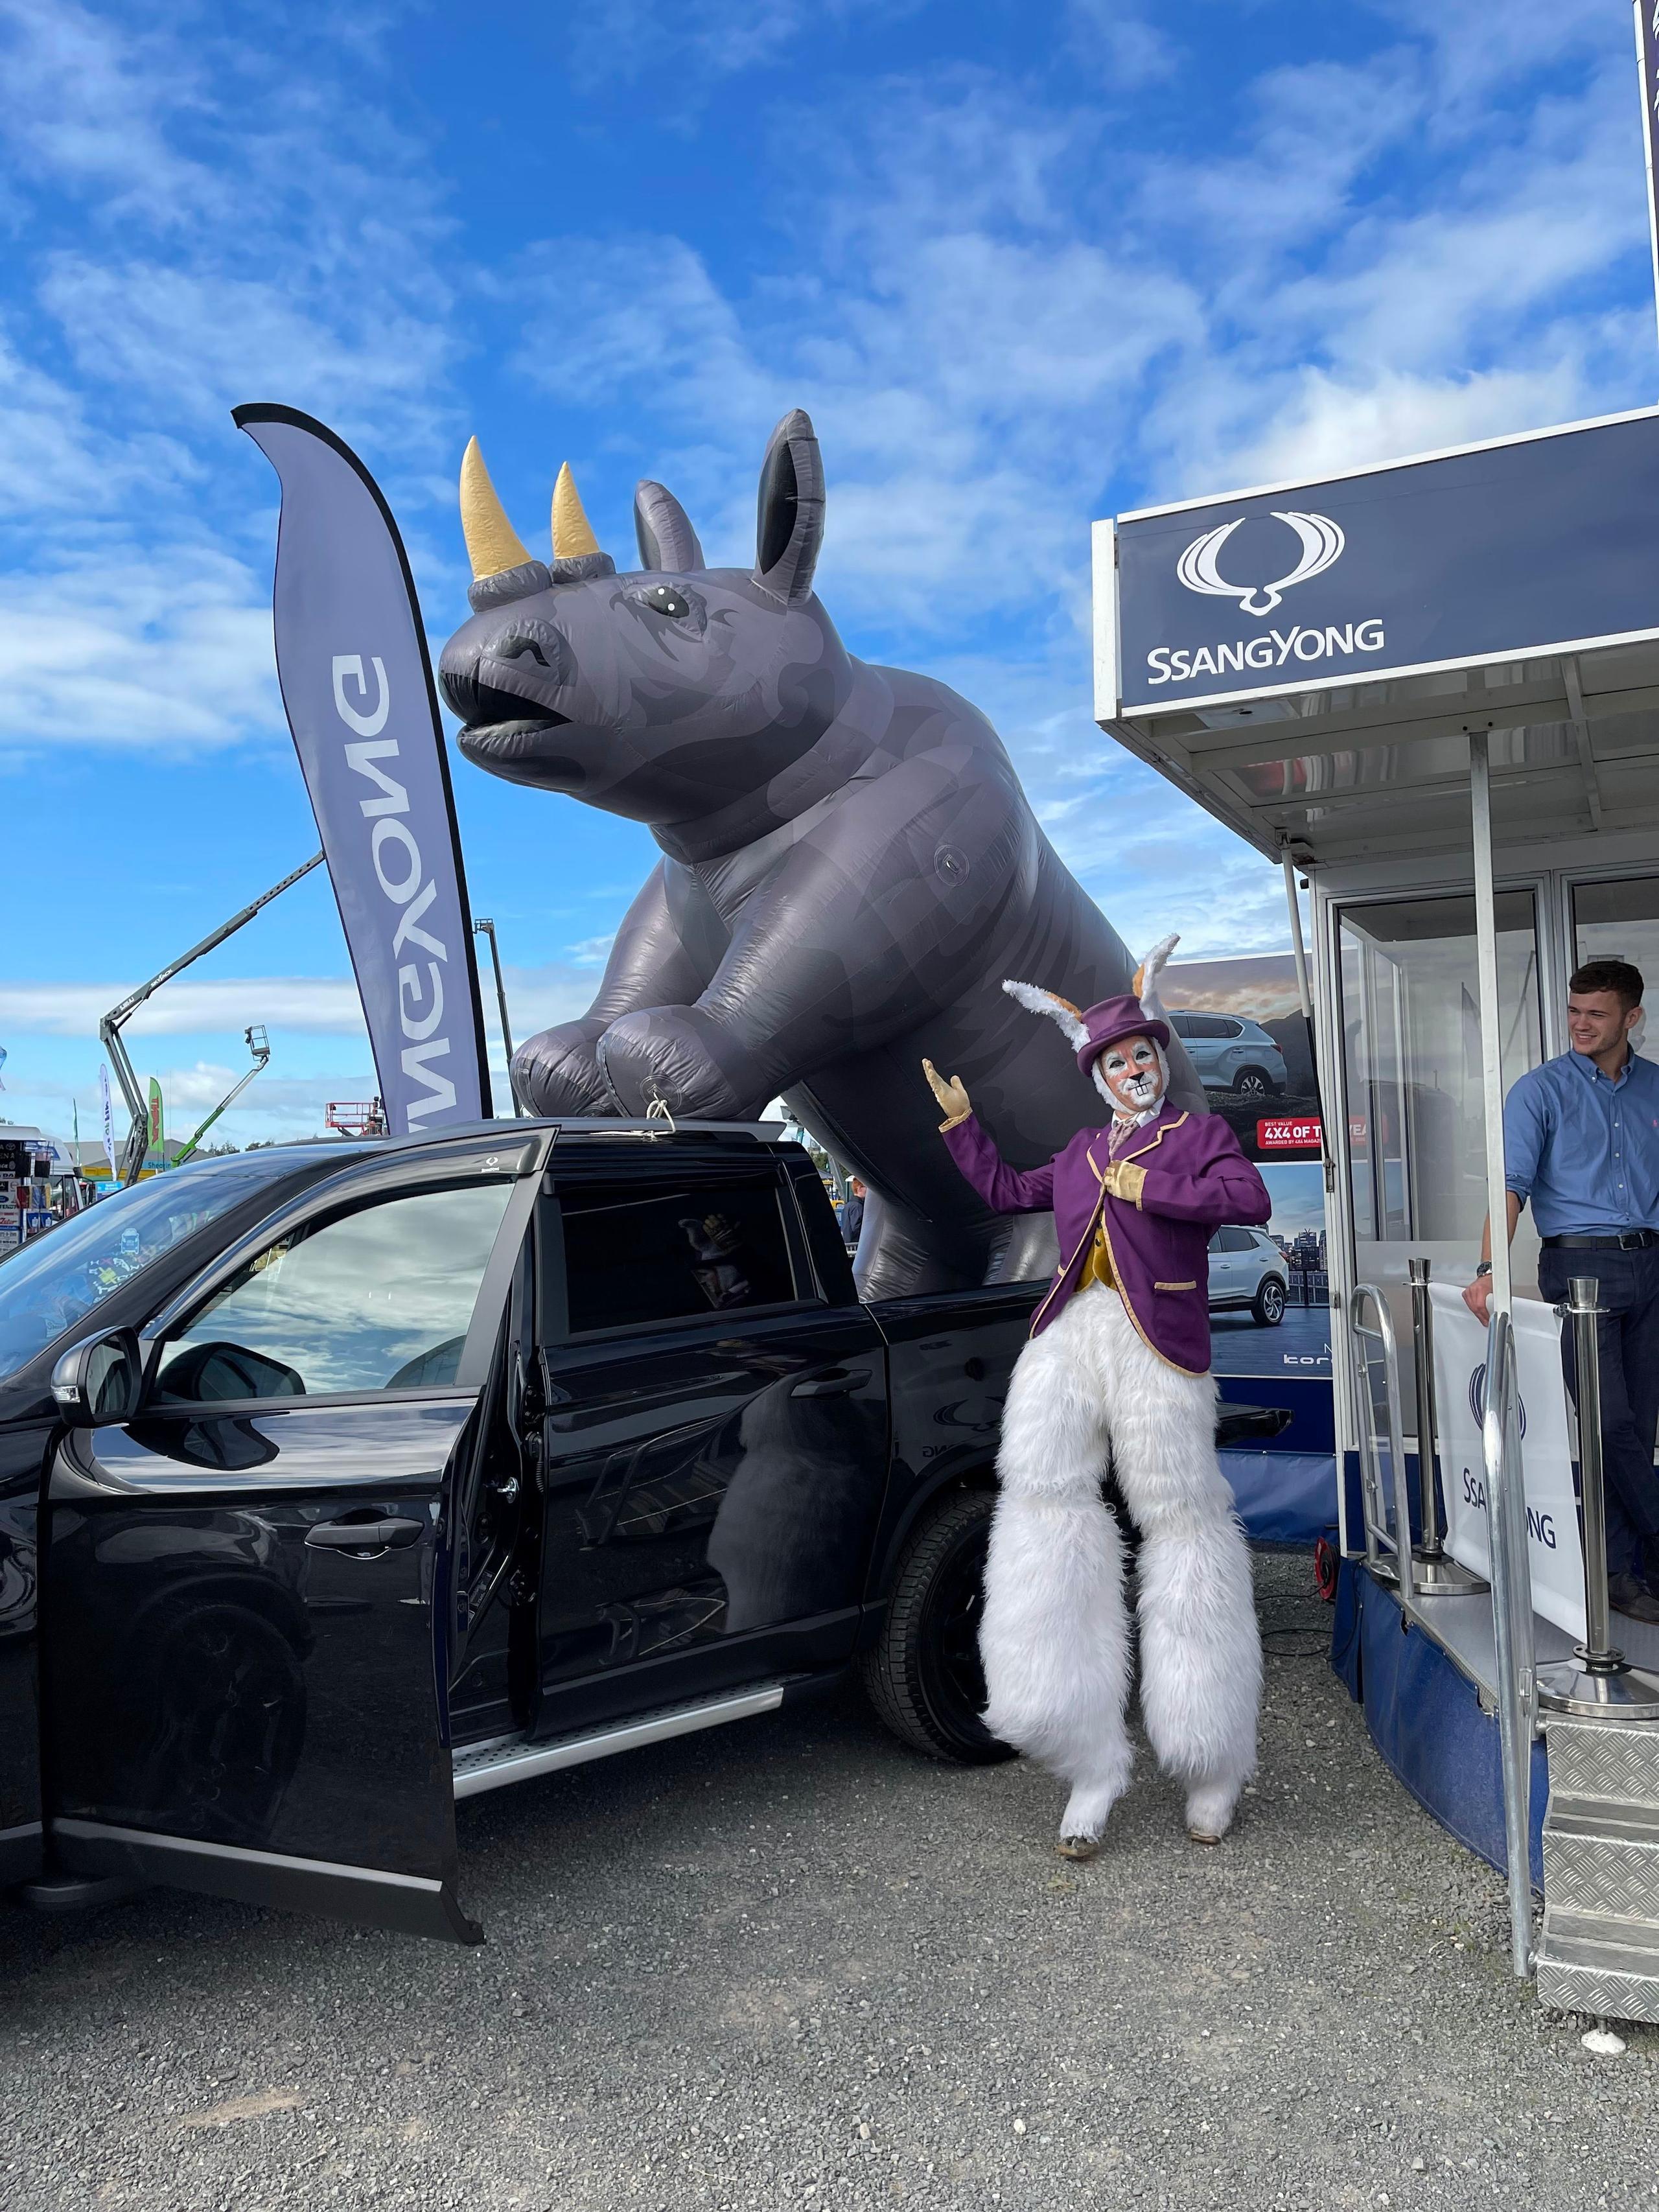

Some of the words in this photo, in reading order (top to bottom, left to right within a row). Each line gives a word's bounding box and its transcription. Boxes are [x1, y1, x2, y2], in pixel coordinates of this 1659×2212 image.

[1264, 1126, 1291, 1139] 4X4
[1292, 1126, 1310, 1138] OF
[1284, 1354, 1332, 1365] kor
